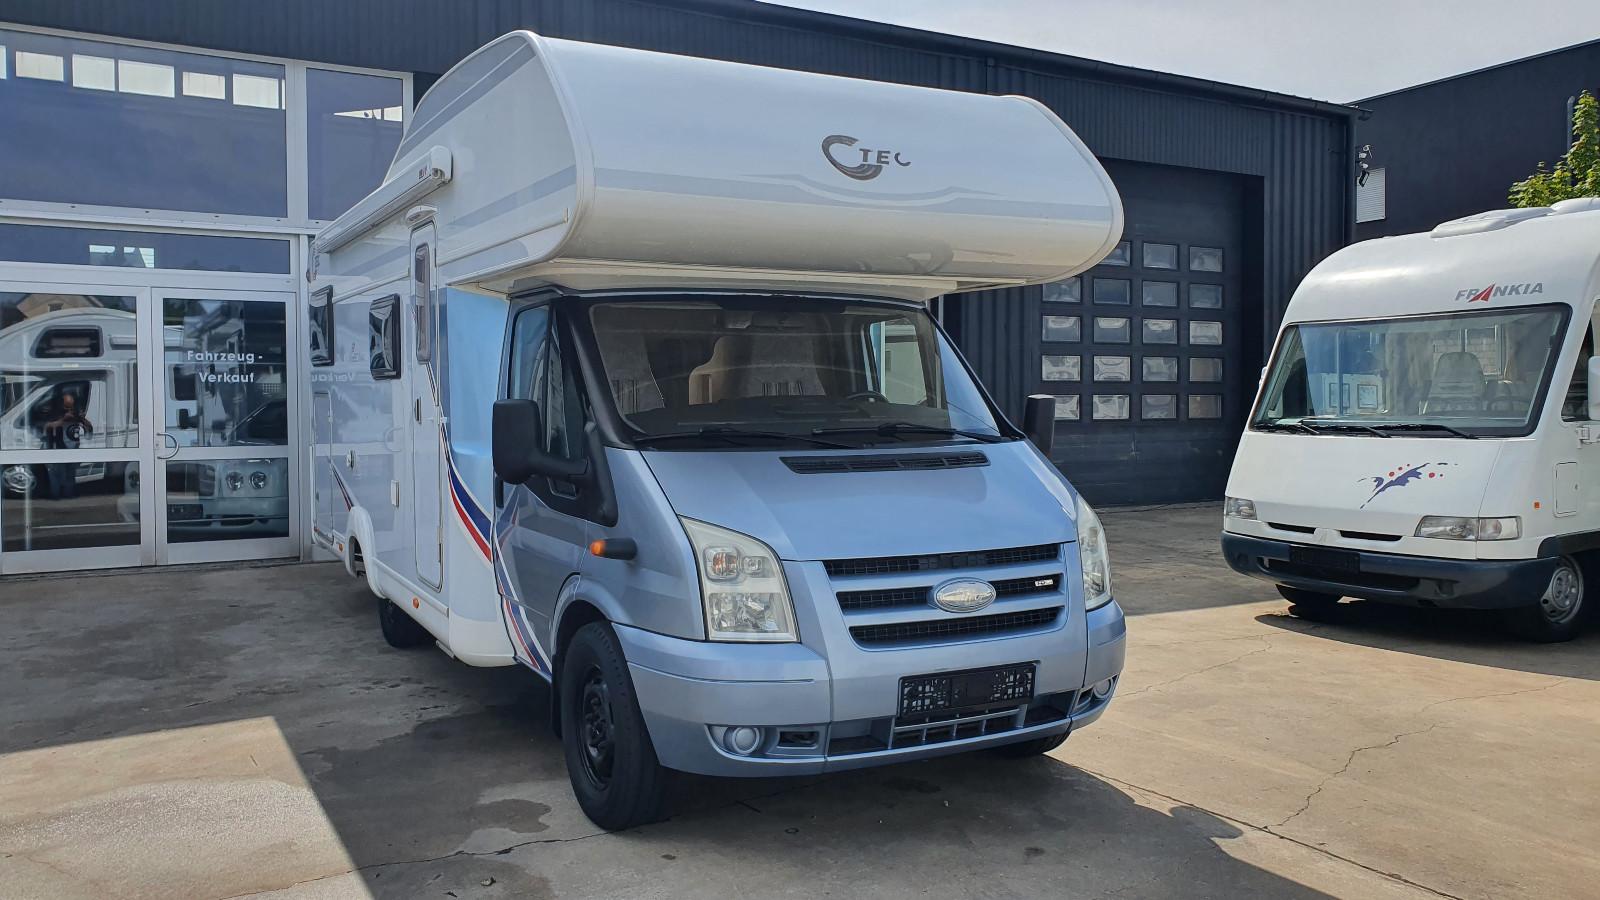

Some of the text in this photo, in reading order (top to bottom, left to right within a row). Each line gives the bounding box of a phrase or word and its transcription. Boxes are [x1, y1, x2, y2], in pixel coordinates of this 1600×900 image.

[1455, 282, 1543, 303] FRANKIA
[187, 350, 255, 364] Fahrzeug
[199, 372, 254, 383] Verkauf
